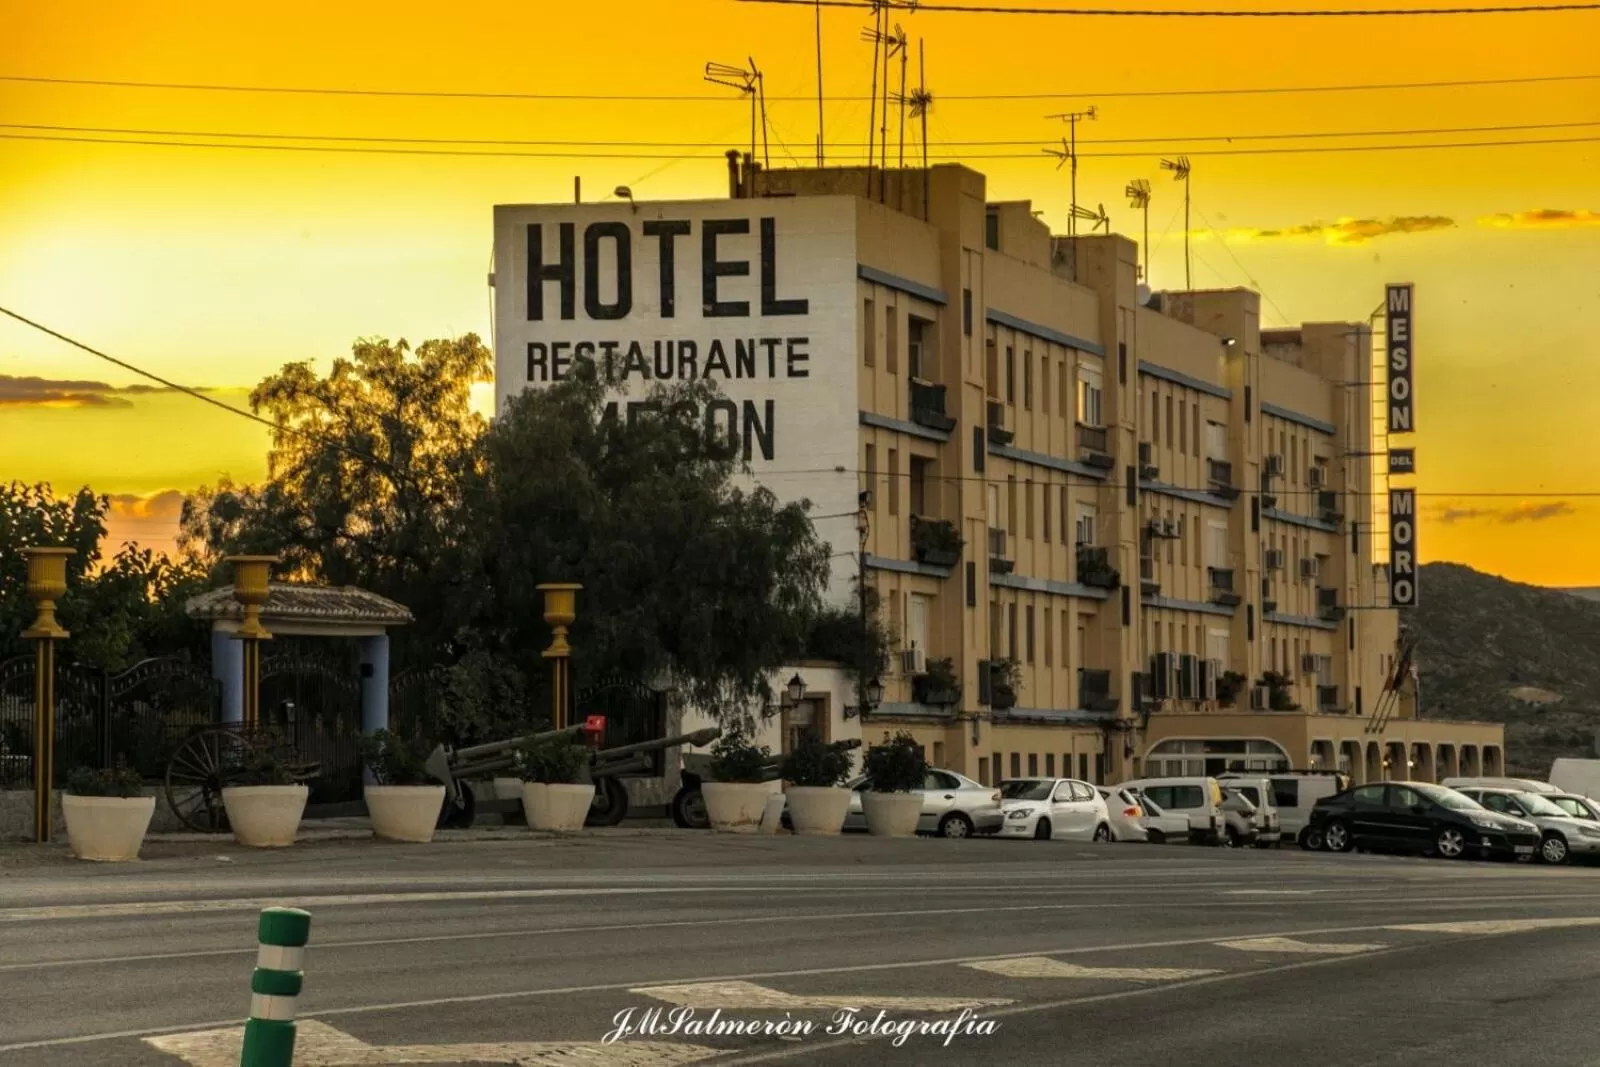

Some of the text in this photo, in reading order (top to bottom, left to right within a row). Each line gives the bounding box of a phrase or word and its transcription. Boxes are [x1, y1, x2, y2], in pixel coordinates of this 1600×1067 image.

[527, 217, 808, 320] HOTEL
[527, 338, 809, 381] RESTAURANTE
[1389, 288, 1413, 603] MESON DEL MORO
